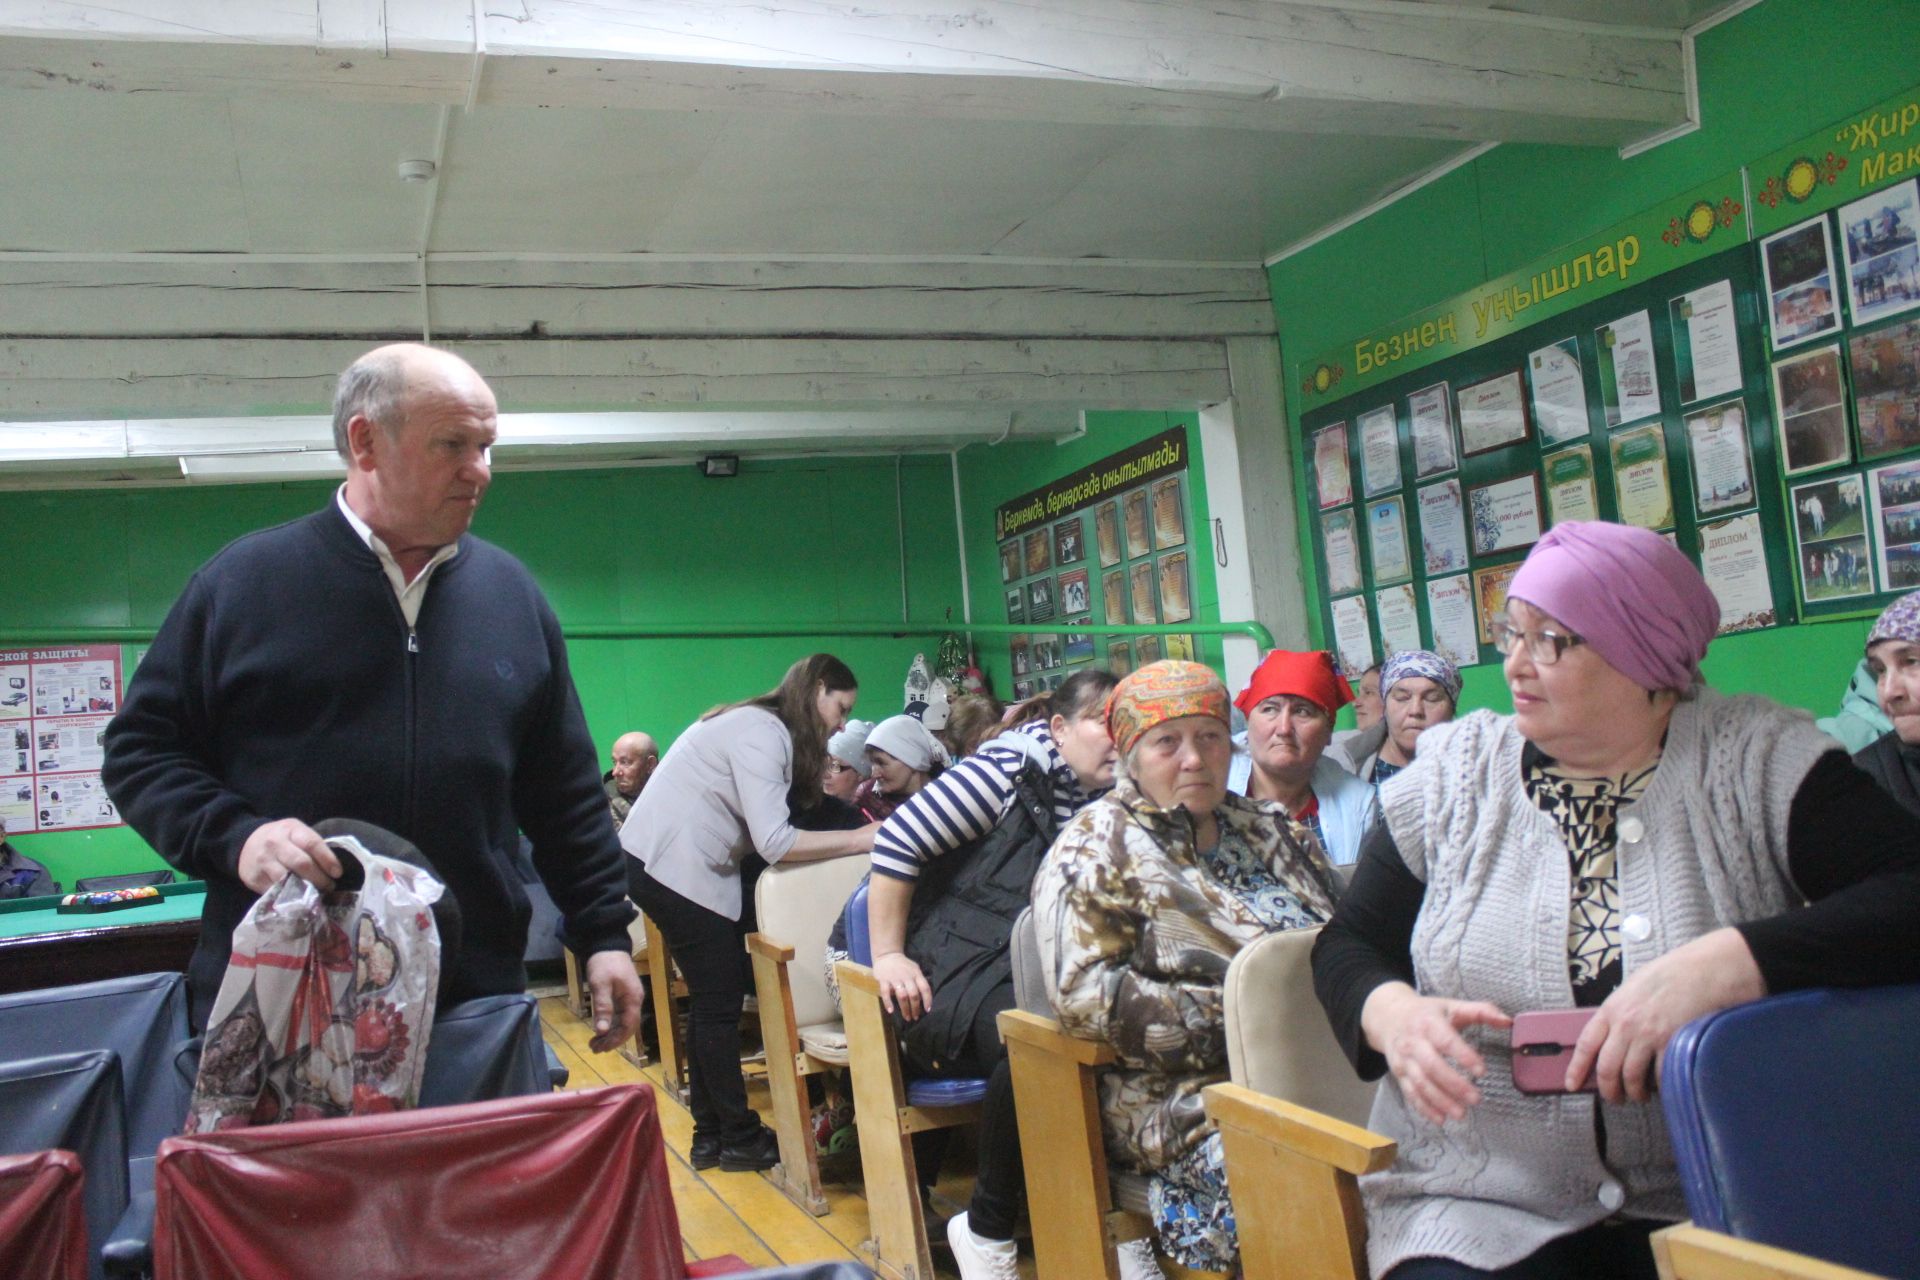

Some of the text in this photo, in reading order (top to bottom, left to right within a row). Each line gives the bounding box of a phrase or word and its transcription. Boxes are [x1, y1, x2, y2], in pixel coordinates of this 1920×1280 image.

[1355, 235, 1640, 375] Безнең уңышлар
[1102, 440, 1180, 491] онытылмады
[1709, 531, 1748, 549] ДИПЛОМ
[32, 649, 89, 660] ЗАЩИТЫ
